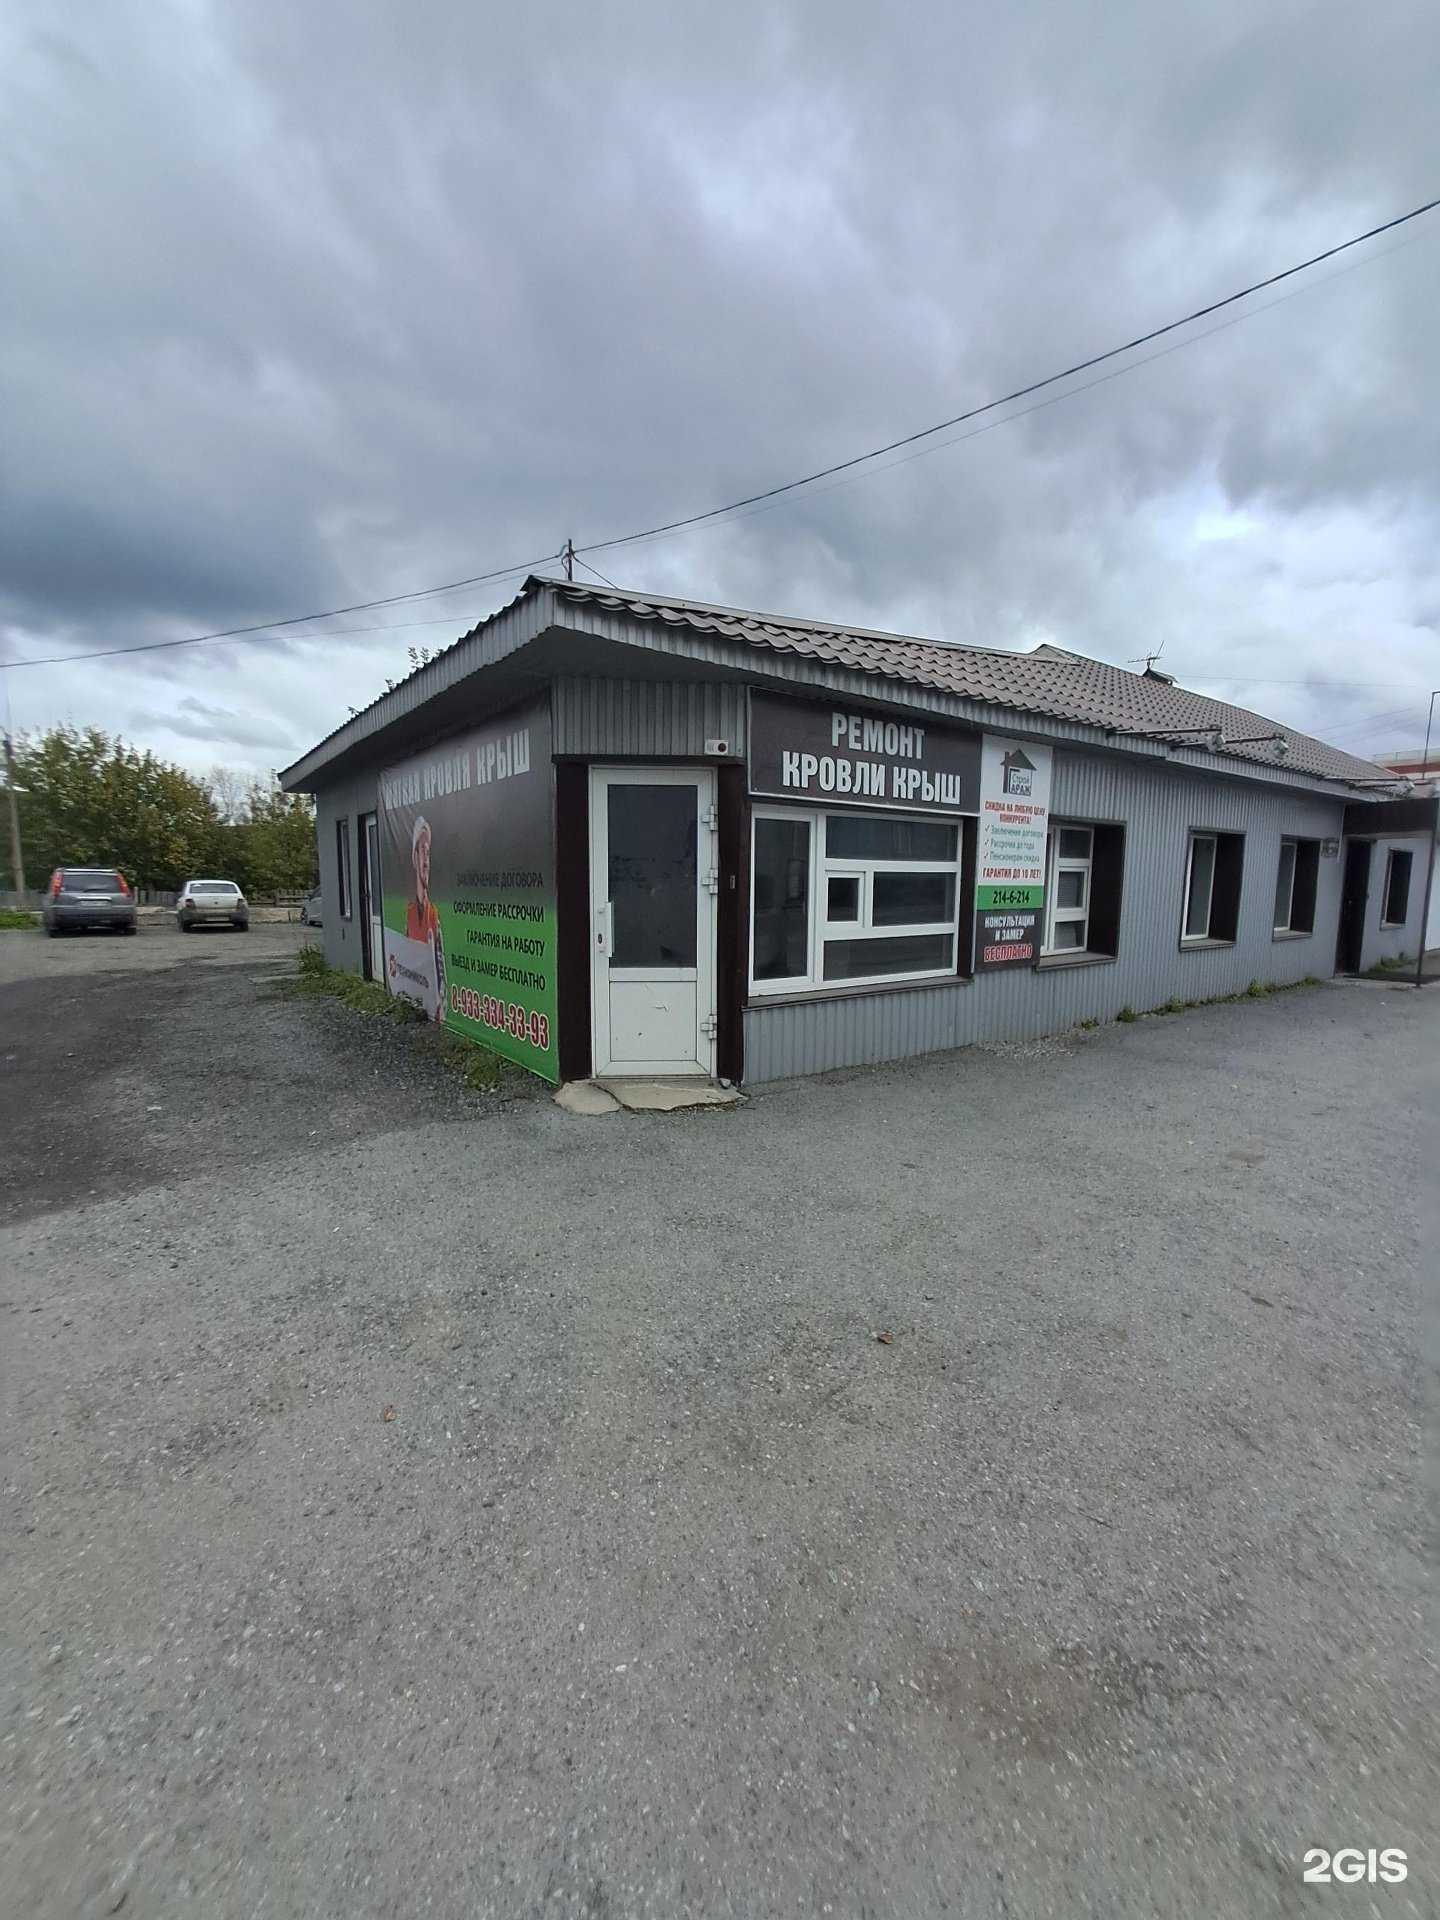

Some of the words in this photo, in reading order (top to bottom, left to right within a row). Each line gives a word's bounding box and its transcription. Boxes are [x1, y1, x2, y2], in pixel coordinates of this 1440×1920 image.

[831, 712, 925, 760] РЕМОНТ
[424, 752, 471, 800] КРОВЛЯ
[477, 728, 530, 785] КРЫШ
[782, 750, 886, 798] КРОВЛИ
[892, 766, 961, 805] КРЫШ
[984, 801, 1005, 812] СКИДКА
[1006, 803, 1013, 812] НА
[1014, 804, 1033, 815] ЛЮБУЮ
[456, 871, 499, 888] ЗАКЛЮЧЕНИЕ
[500, 872, 543, 891] ДОГОВОРА
[983, 867, 1011, 878] ГАРАНТИЯ
[1012, 868, 1020, 879] ДО
[1022, 868, 1029, 879] 10
[1030, 868, 1041, 879] ЛЕТ!
[993, 890, 1030, 904] 214-6-214
[453, 901, 497, 918] ОФОРМЛЕНИЕ
[498, 904, 544, 923] РАССРОЧКИ
[984, 915, 1035, 928] КОНСУЛЬТАЦИЯ
[466, 930, 500, 948] ГАРАНТИЯ
[501, 936, 513, 951] НА
[514, 937, 545, 957] РАБОТУ
[995, 930, 1001, 941] И
[1001, 928, 1024, 941] ЗАМЕР
[984, 944, 1033, 962] БЕСПЛАТНО
[451, 953, 470, 972] ВЫЕЗД
[470, 959, 476, 971] И
[477, 959, 498, 978] ЗАМЕР
[500, 965, 545, 991] БЕСПЛАТНО
[451, 984, 550, 1051] 8-933-334-33-93
